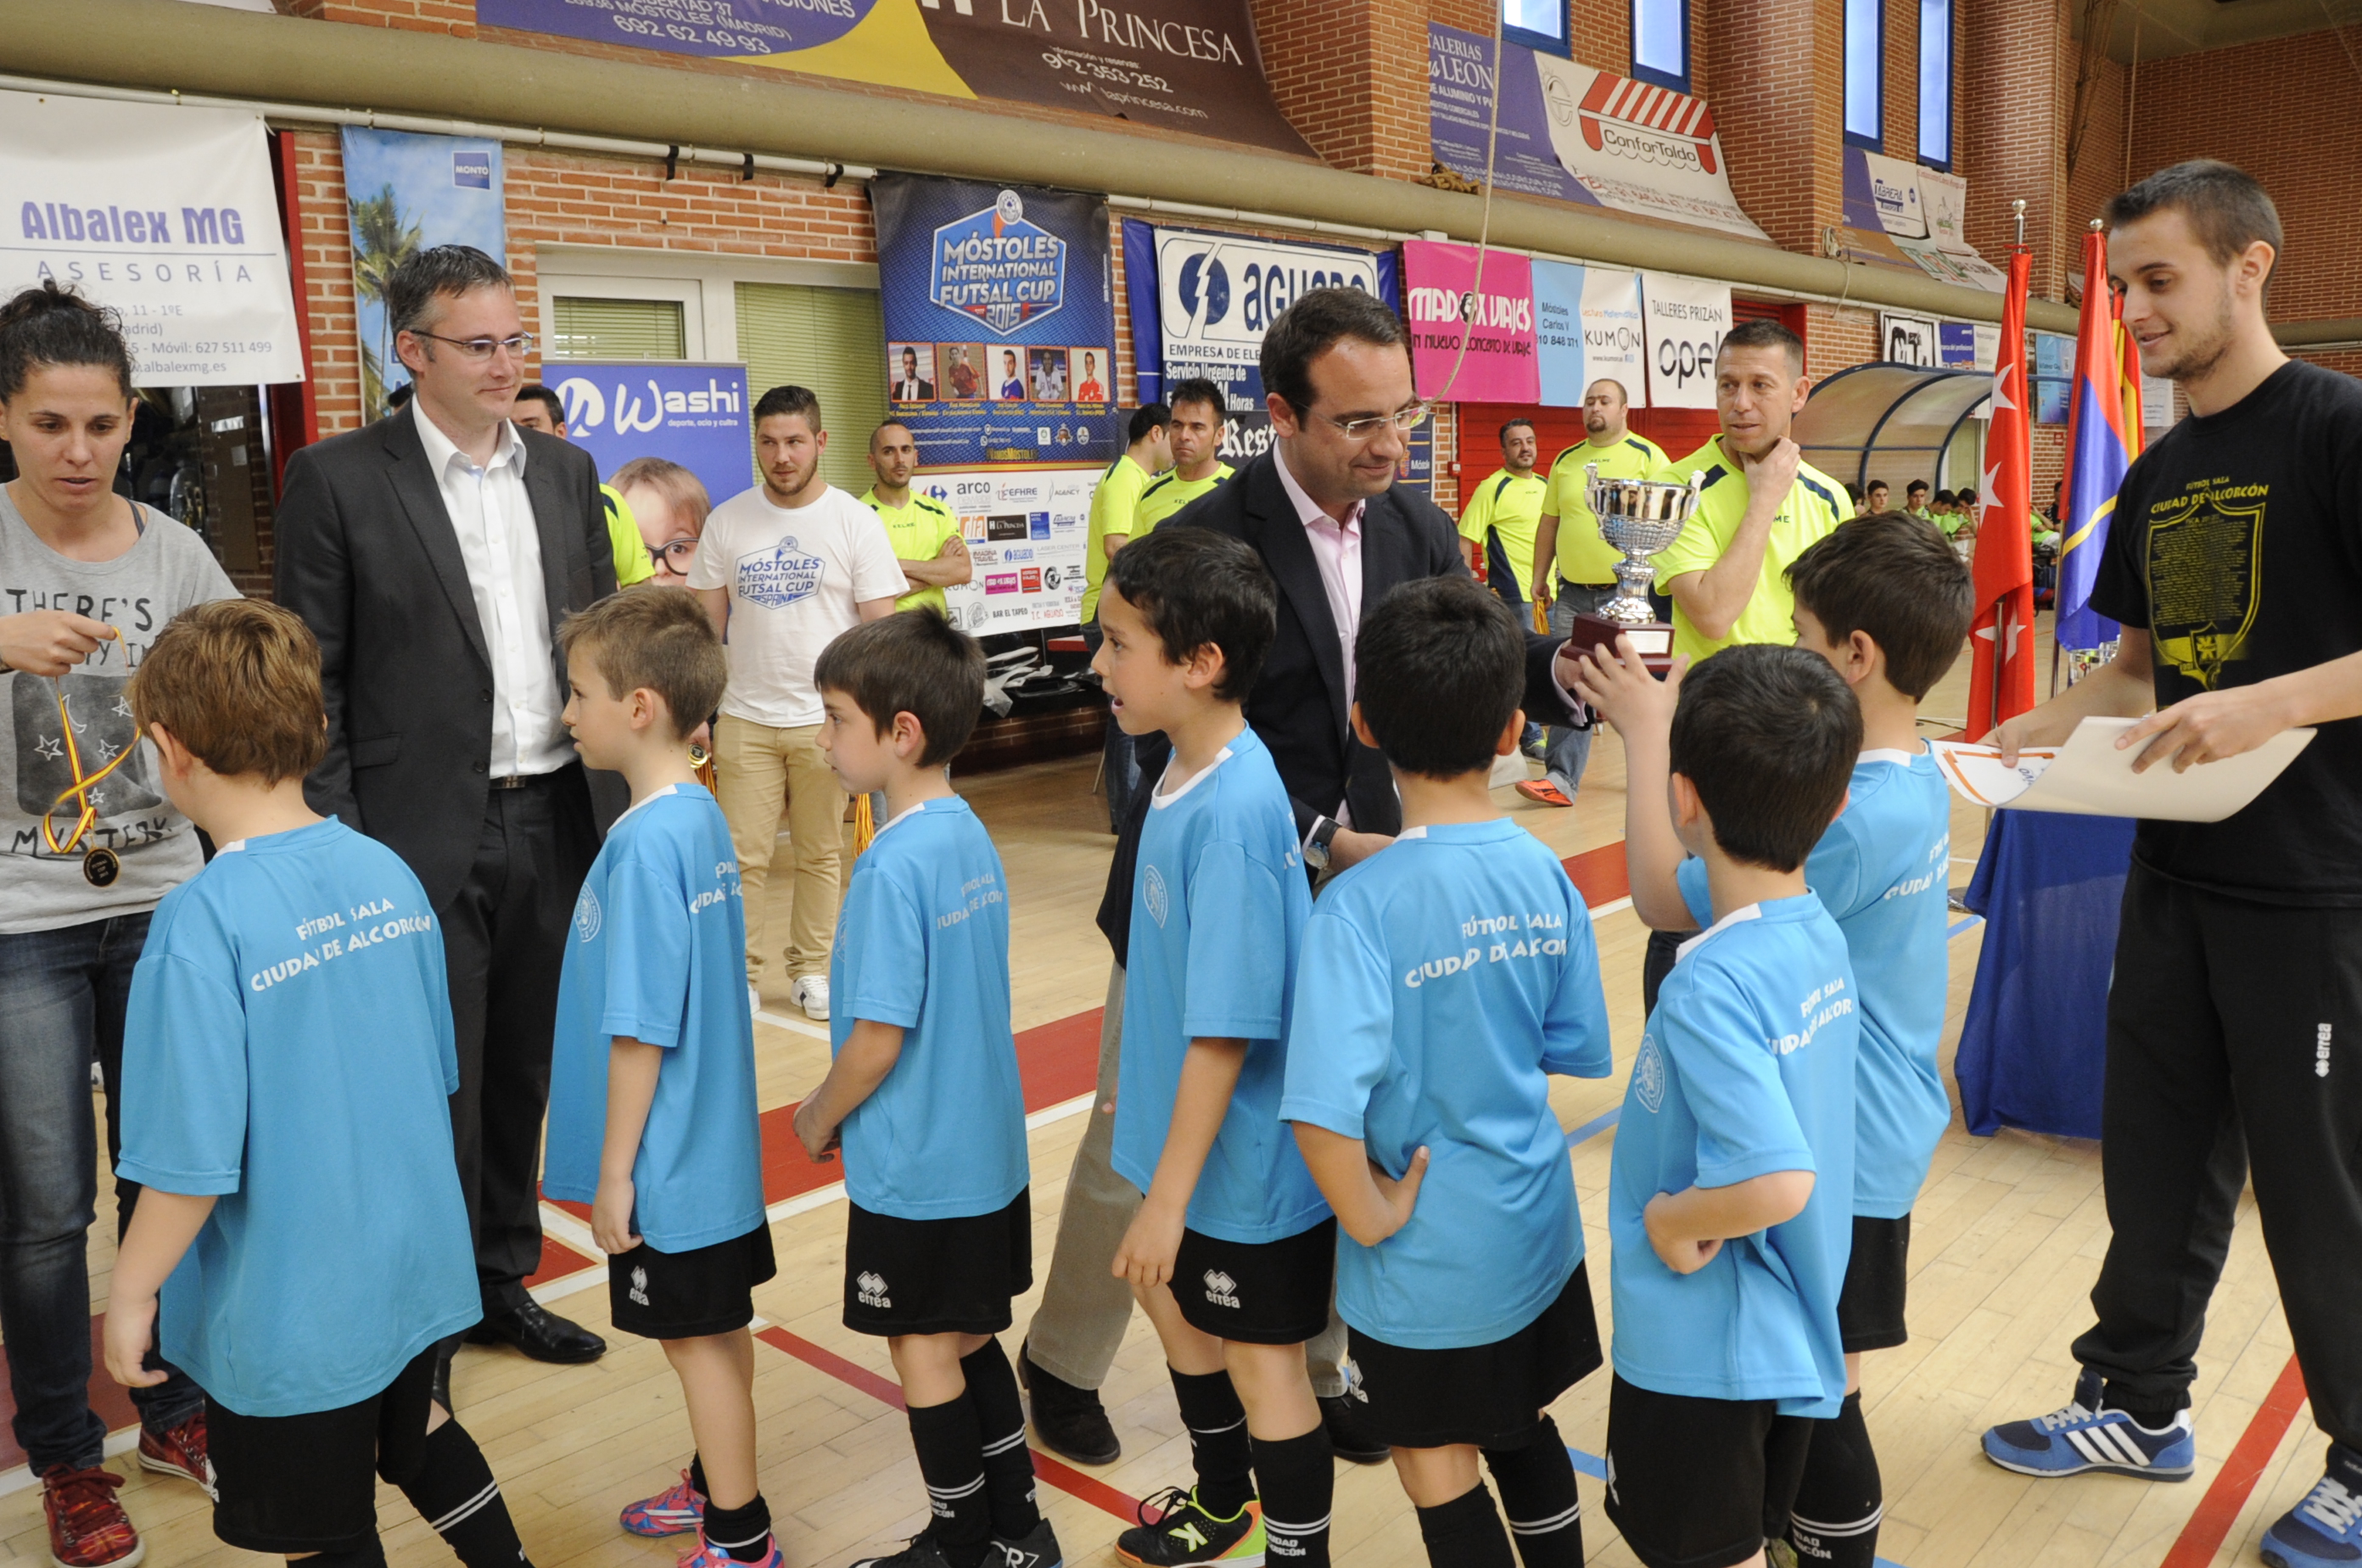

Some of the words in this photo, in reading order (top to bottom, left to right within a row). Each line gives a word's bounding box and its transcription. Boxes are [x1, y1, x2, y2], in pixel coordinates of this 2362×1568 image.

[714, 2, 732, 16] 37
[613, 14, 665, 37] 692
[666, 24, 702, 43] 62
[706, 30, 736, 48] 49
[736, 35, 771, 54] 93
[716, 15, 792, 42] (MADRID)
[1001, 0, 1051, 32] LA
[1076, 0, 1244, 65] PRINCESA
[1087, 63, 1130, 84] 353
[1130, 72, 1173, 93] 252
[1476, 94, 1482, 105] Y
[1604, 129, 1696, 162] ConforToldo
[456, 165, 489, 176] MONTO
[21, 201, 171, 244] Albalex
[182, 207, 245, 244] MG
[943, 231, 1059, 265] MÓSTOLES
[36, 260, 252, 283] ASESORÍA
[942, 260, 1056, 282] INTERNATIONAL
[939, 281, 1013, 307] FUTSAL
[1016, 279, 1056, 301] CUP
[132, 305, 147, 316] 11
[986, 302, 1021, 329] 2015
[1542, 302, 1569, 316] Móstoles
[1652, 300, 1688, 320] TALLERES
[1689, 304, 1722, 322] PRIZÁN
[124, 321, 163, 335] adrid)
[1542, 318, 1564, 331] Carlos
[1564, 321, 1570, 331] V
[152, 342, 193, 354] Móvil:
[195, 342, 217, 354] 627
[222, 341, 245, 353] 511
[249, 341, 271, 353] 499
[1584, 327, 1641, 351] KUMON
[1169, 344, 1223, 357] EMPRESA
[1227, 348, 1240, 360] DE
[130, 361, 227, 373] w.albalexmg.es
[1166, 361, 1200, 379] Servicio
[1201, 362, 1234, 384] Urgente
[1235, 365, 1246, 381] de
[613, 378, 740, 435] Washi
[1230, 393, 1254, 411] Horas
[668, 418, 695, 428] deporte,
[697, 418, 712, 427] ocio
[713, 420, 718, 428] y
[957, 482, 990, 495] arco
[2151, 496, 2188, 514] CIUDAD
[2191, 493, 2206, 505] DE
[739, 557, 820, 574] MÓSTOLES
[738, 571, 816, 583] INTERNATIONAL
[738, 583, 782, 597] FUTSAL
[786, 581, 814, 591] CUP
[1011, 608, 1028, 616] TAPEO
[350, 898, 395, 921] SALA
[937, 907, 970, 930] IUDA
[250, 949, 320, 992] CIUDA
[322, 938, 343, 960] DE
[1766, 1028, 1811, 1056] IUDA
[2316, 1022, 2332, 1060] errea
[858, 1291, 892, 1308] errea
[1205, 1290, 1240, 1309] errea
